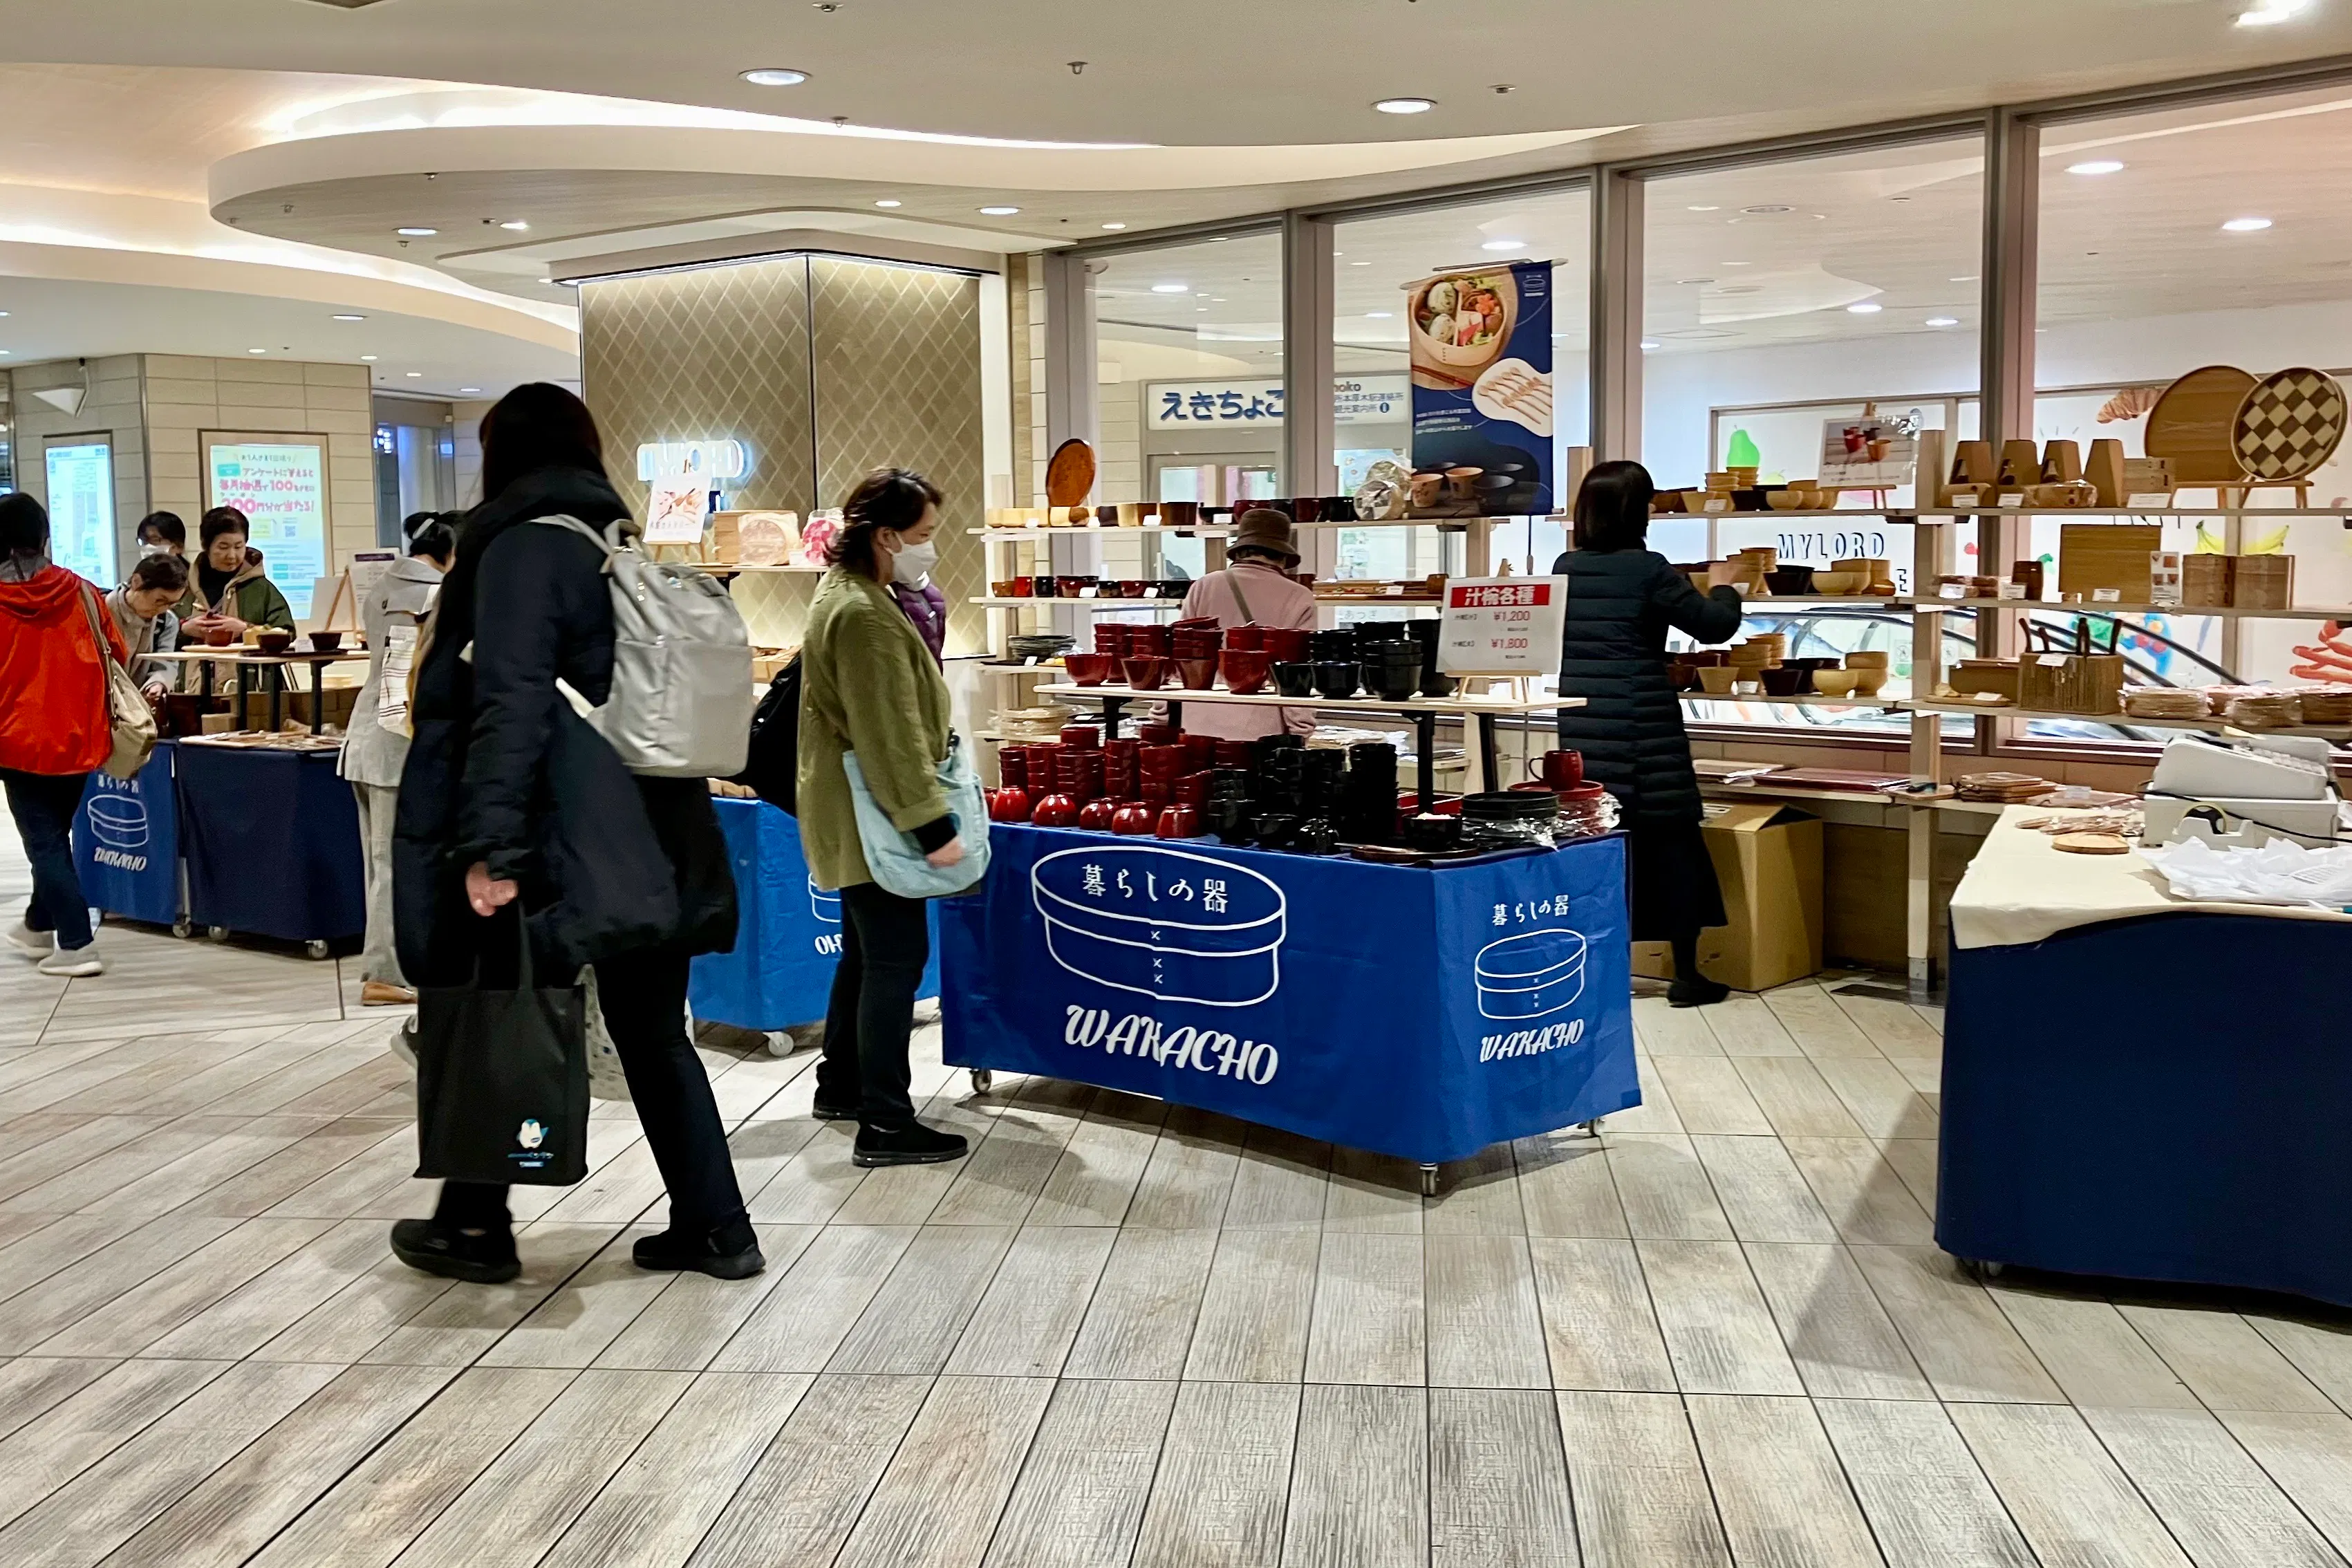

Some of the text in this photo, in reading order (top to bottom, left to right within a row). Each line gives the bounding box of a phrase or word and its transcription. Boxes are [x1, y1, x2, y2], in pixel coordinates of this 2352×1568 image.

[1777, 532, 1884, 559] MYLORD
[1082, 864, 1229, 913] 暮らしの器
[1492, 895, 1569, 926] 暮らしの器
[1065, 1005, 1278, 1085] WAKACHO
[1480, 1019, 1585, 1063] WAKACHO
